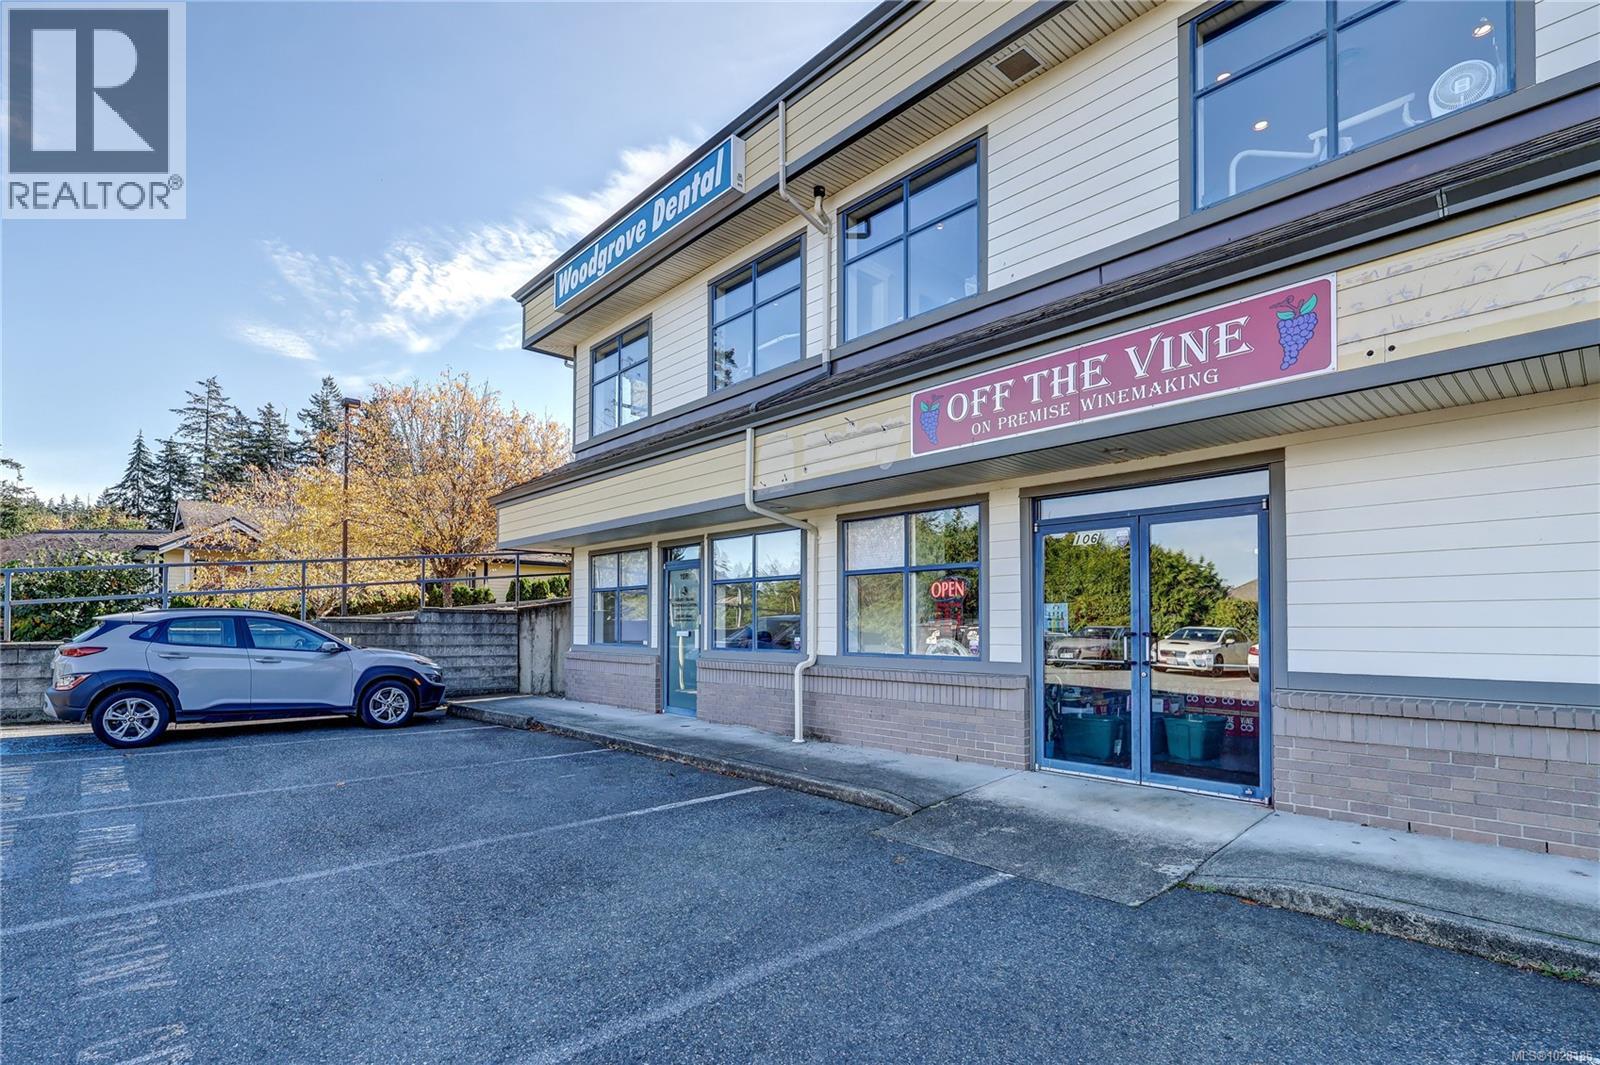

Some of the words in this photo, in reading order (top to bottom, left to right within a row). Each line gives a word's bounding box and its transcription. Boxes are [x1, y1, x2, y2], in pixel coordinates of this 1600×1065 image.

[558, 218, 647, 299] Woodgrove
[651, 147, 725, 233] Dental
[947, 379, 1016, 422] OFF
[1023, 353, 1112, 404] THE
[1124, 315, 1256, 380] VINE
[971, 418, 992, 436] ON
[997, 401, 1071, 431] PREMISE
[1080, 368, 1220, 412] WINEMAKING
[1075, 533, 1098, 545] 106
[930, 580, 965, 598] OPEN
